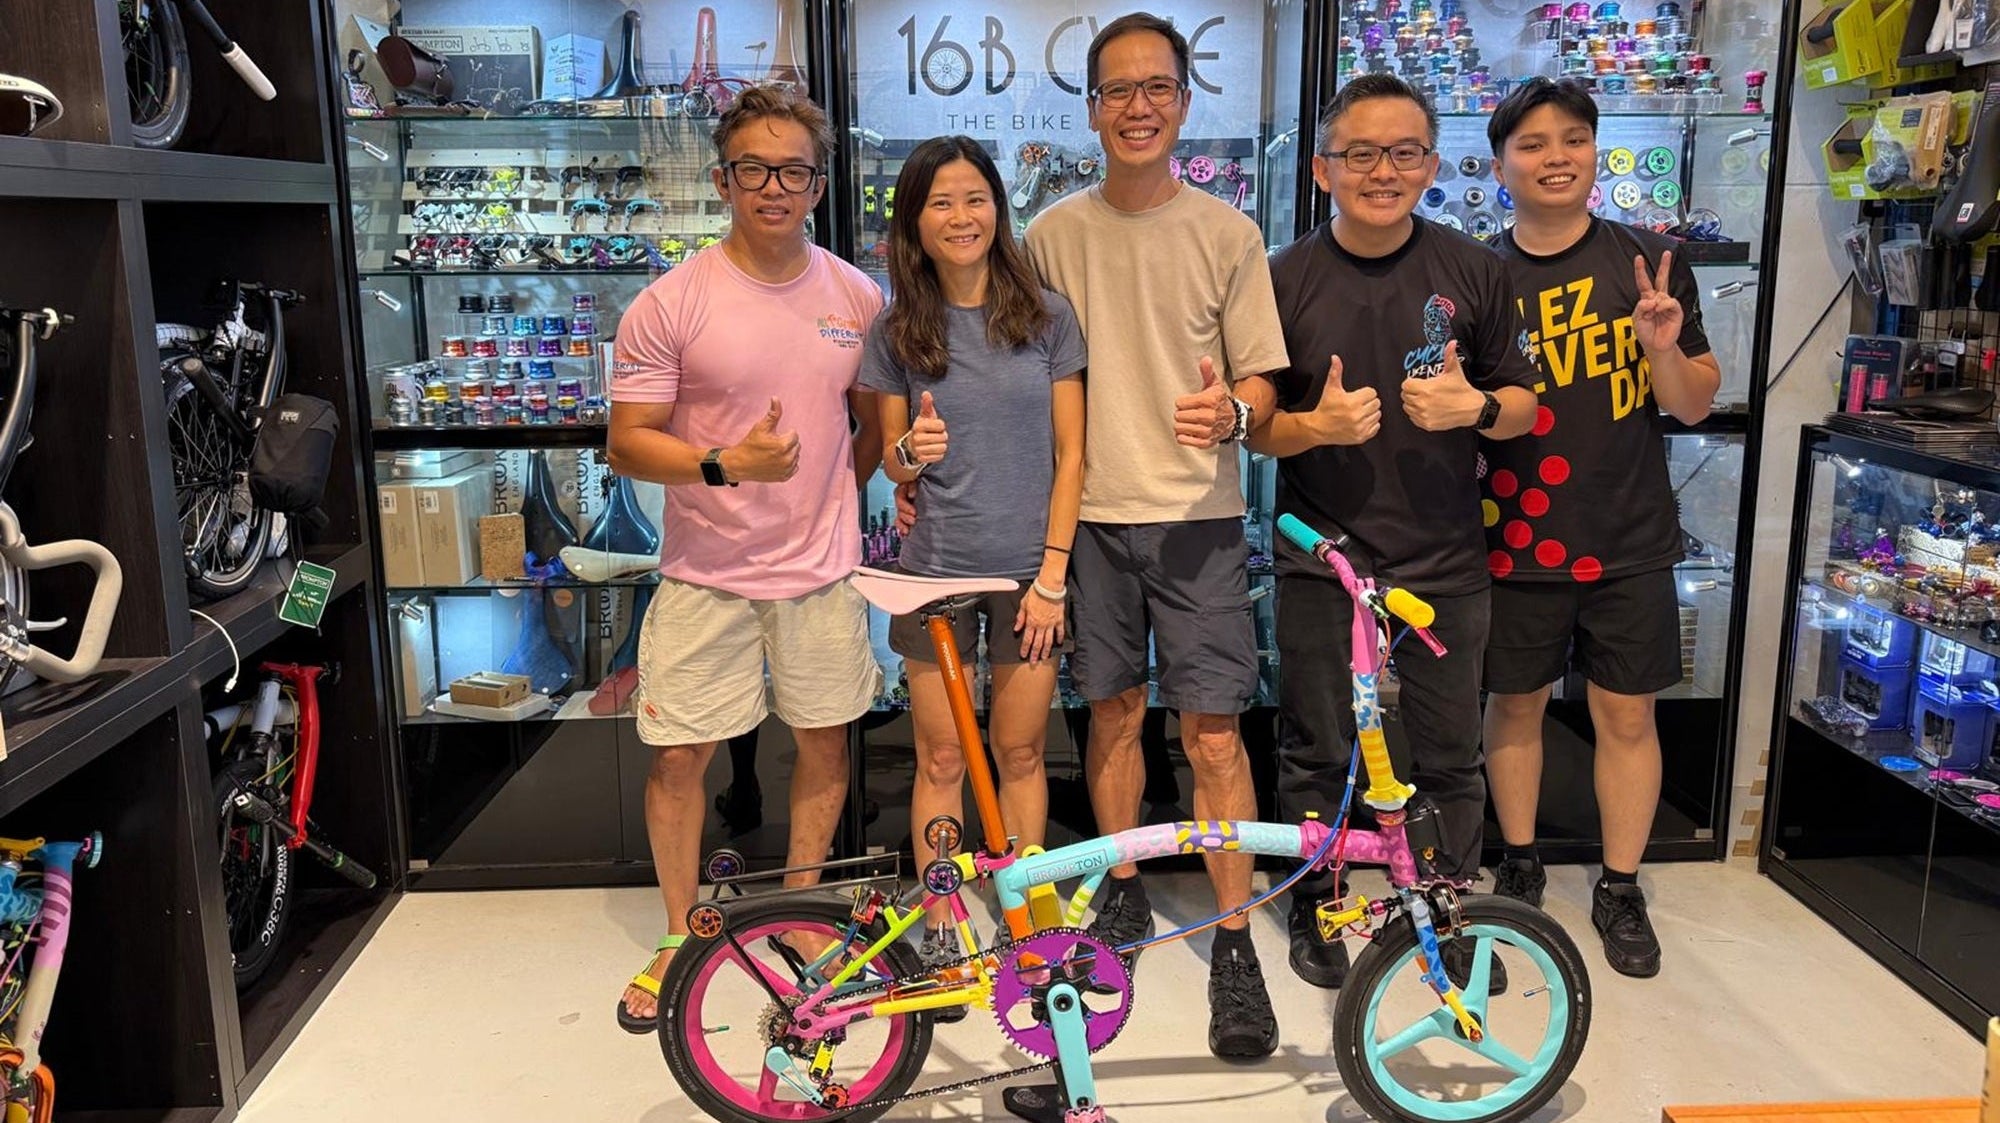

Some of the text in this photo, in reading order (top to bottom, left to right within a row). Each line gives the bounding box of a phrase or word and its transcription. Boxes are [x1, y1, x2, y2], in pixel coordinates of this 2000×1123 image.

[947, 114, 996, 130] THE
[1012, 114, 1072, 130] BIKE
[1404, 344, 1445, 370] CYCL
[1610, 356, 1650, 421] DA
[495, 449, 507, 514] BROOK
[511, 452, 519, 498] ENGLAND
[577, 448, 588, 514] BROOK
[600, 588, 612, 639] BROO
[1033, 856, 1103, 882] BROMPTON
[261, 896, 284, 947] C38C
